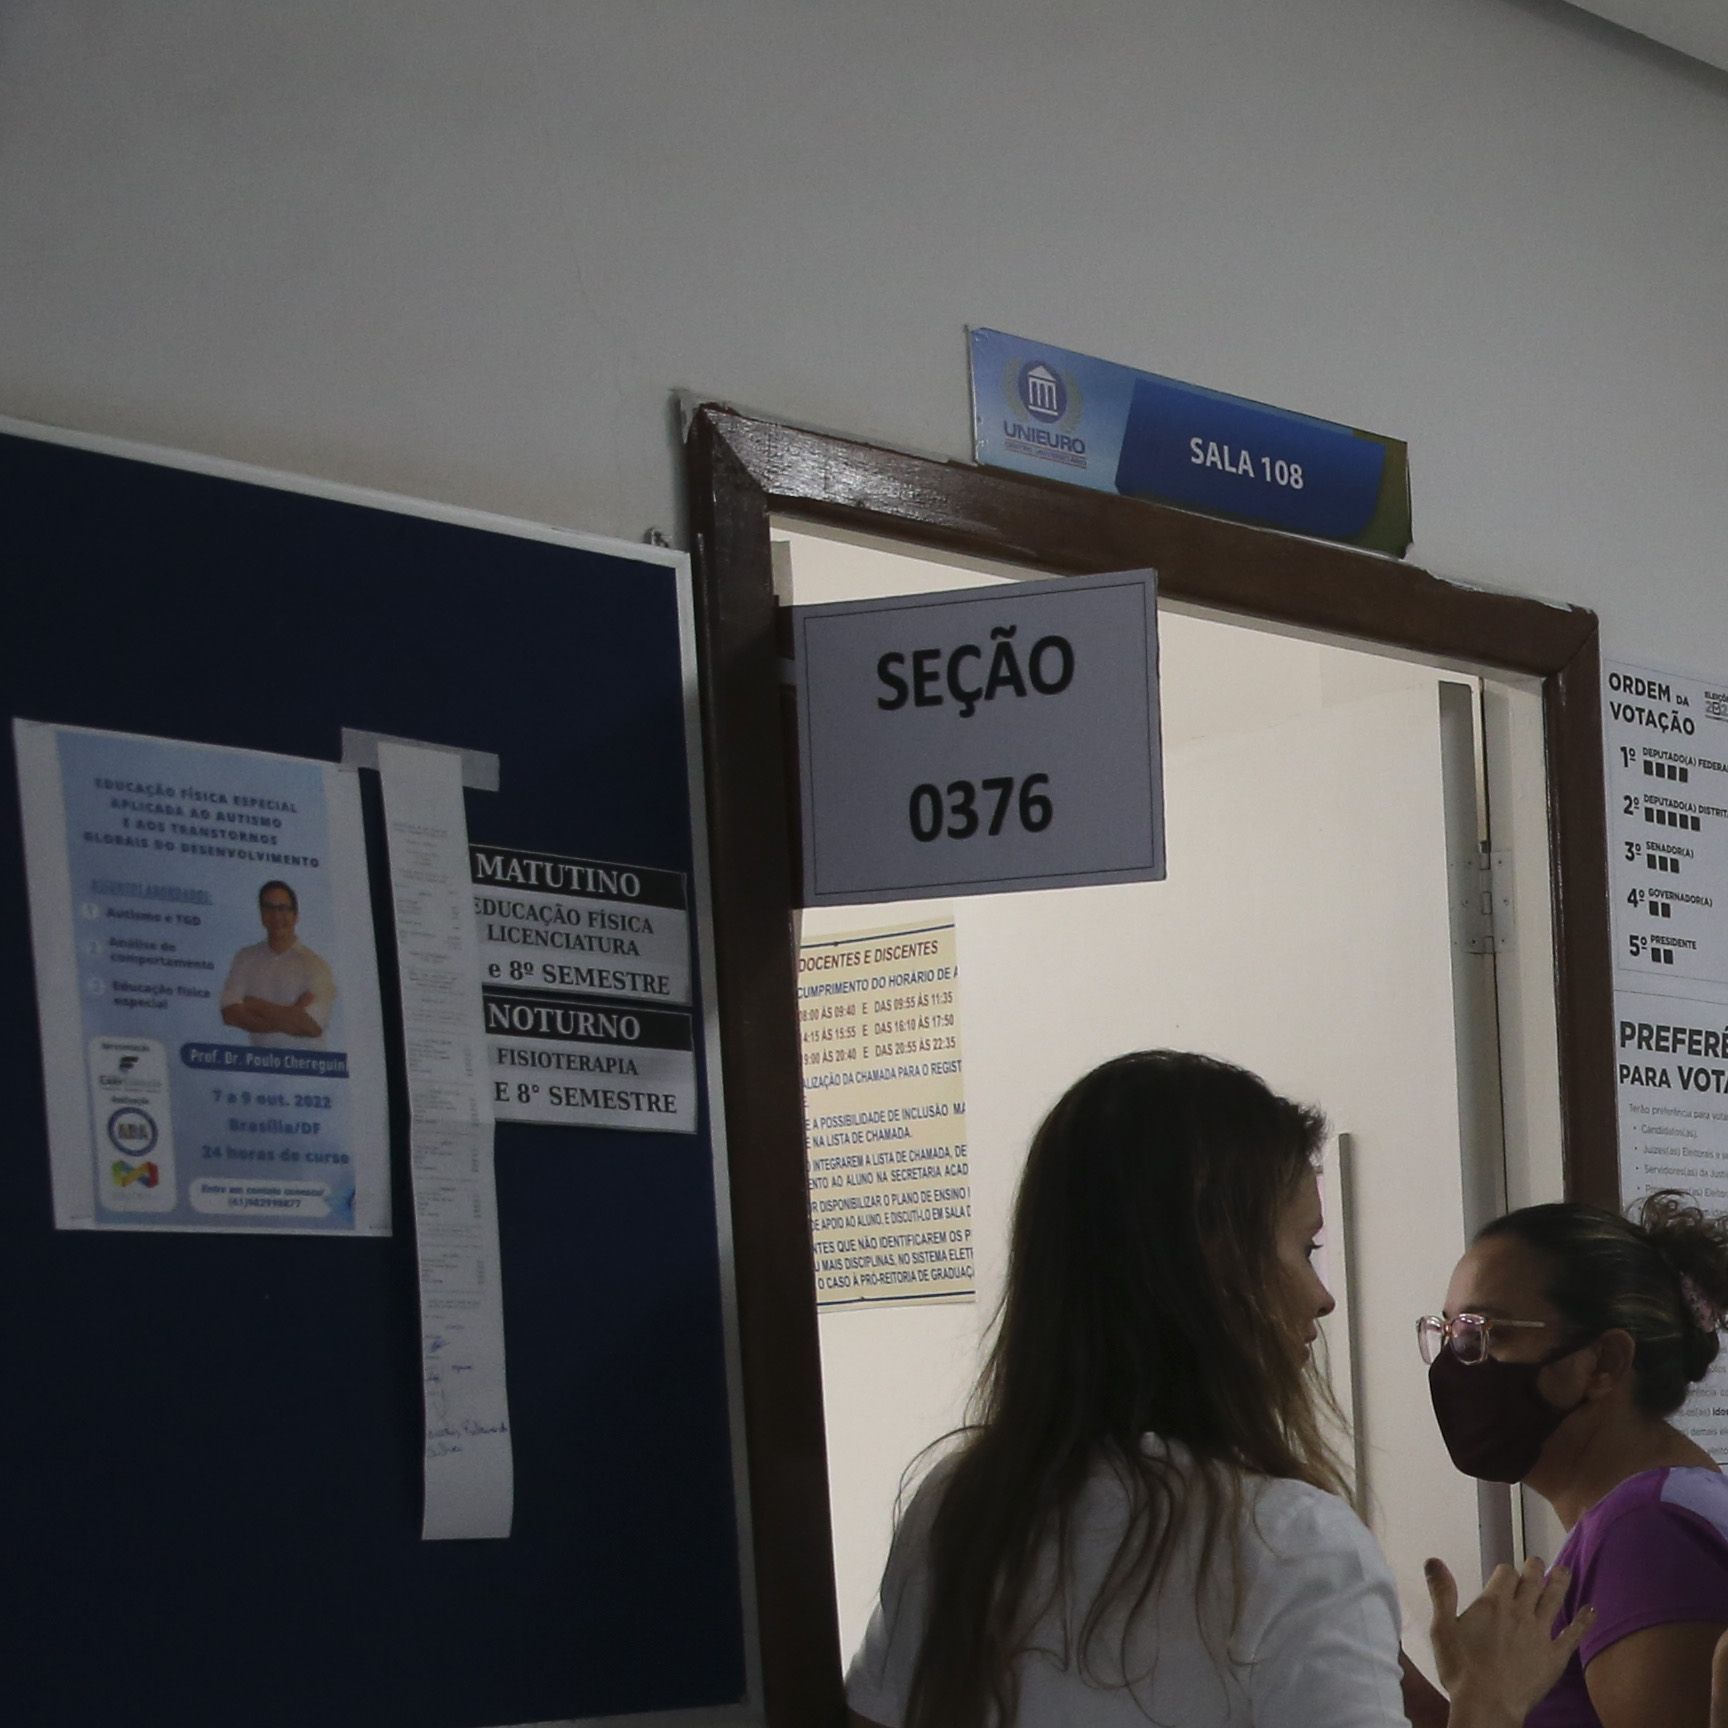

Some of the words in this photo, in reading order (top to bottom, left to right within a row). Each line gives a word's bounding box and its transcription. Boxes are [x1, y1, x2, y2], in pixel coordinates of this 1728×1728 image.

[1004, 420, 1086, 454] UNIEURO
[1190, 436, 1254, 479] SALA
[1261, 456, 1304, 490] 108
[877, 625, 1074, 719] SEÇÃO
[1609, 673, 1671, 702] ORDEM
[1676, 695, 1689, 706] DA
[1610, 701, 1695, 736] VOTAÇÃO
[1620, 746, 1636, 767] 1º
[1643, 747, 1696, 767] DEPUTADO(A)
[94, 778, 174, 798] EDUCAÇÃO
[181, 787, 227, 804] FÍSICA
[234, 795, 297, 813] ESPECIAL
[909, 773, 1052, 843] 0376
[1624, 795, 1639, 815] 2º
[1644, 794, 1696, 813] DEPUTADO(A)
[111, 798, 183, 815] APLICADA
[191, 808, 210, 820] AO
[216, 811, 282, 828] AUTISMO
[136, 820, 165, 832] AOS
[172, 823, 277, 845] TRANSTORNOS
[84, 831, 149, 848] GLOBAIS
[155, 840, 174, 851] DO
[181, 843, 319, 868] DESENVOLVIMENTO
[1625, 841, 1641, 861] 3º
[1646, 841, 1694, 858] SENADOR(A)
[476, 853, 640, 897] MATUTINO
[1627, 888, 1645, 908] 4º
[1648, 888, 1712, 907] GOVERNADOR(A)
[106, 908, 160, 922] Autismo
[474, 897, 580, 926] EDUCAÇÃO
[588, 909, 654, 934] FÍSICA
[488, 924, 640, 956] LICENCIATURA
[1629, 935, 1647, 956] 5º
[1651, 935, 1696, 949] PRESIDENTE
[111, 953, 214, 970] comportamento
[800, 952, 860, 972] DOCENTES
[864, 950, 870, 963] E
[875, 940, 938, 963] DISCENTES
[113, 981, 173, 996] Educação
[488, 963, 501, 978] e
[510, 961, 533, 980] 8º
[542, 964, 670, 995] SEMESTRE
[797, 979, 868, 999] CUMPRIMENTO
[872, 977, 885, 988] DO
[889, 969, 933, 987] HORÁRIO
[938, 967, 950, 979] DE
[863, 1003, 868, 1014] E
[875, 1000, 891, 1013] DAS
[932, 992, 952, 1005] 11:35
[488, 1003, 640, 1040] NOTURNO
[803, 1030, 819, 1042] 4:15
[863, 1025, 868, 1036] E
[875, 1022, 891, 1035] DAS
[932, 1014, 954, 1027] 17:50
[190, 1049, 220, 1064] Prof.
[224, 1052, 242, 1065] Dr.
[247, 1053, 280, 1068] Paulo
[498, 1048, 638, 1075] FISIOTERAPIA
[804, 1052, 819, 1065] 9:00
[864, 1047, 868, 1058] E
[875, 1044, 892, 1057] DAS
[933, 1036, 955, 1049] 22:35
[803, 1073, 840, 1089] ALIZAÇÃO
[842, 1072, 853, 1084] DA
[856, 1067, 895, 1083] CHAMADA
[899, 1065, 920, 1079] PARA
[922, 1064, 927, 1075] O
[932, 1060, 961, 1075] REGIST
[1620, 1064, 1671, 1088] PARA
[213, 1090, 222, 1102] 7
[257, 1092, 289, 1106] out.
[295, 1095, 331, 1108] 2022
[495, 1082, 509, 1102] E
[550, 1087, 677, 1113] SEMESTRE
[230, 1118, 320, 1135] Brasília/DF
[821, 1110, 885, 1129] POSSIBILIDADE
[888, 1109, 900, 1121] DE
[903, 1103, 948, 1119] INCLUSÃO
[814, 1136, 824, 1148] NA
[827, 1132, 850, 1146] LISTA
[852, 1132, 863, 1144] DE
[227, 1145, 274, 1161] horas
[306, 1153, 349, 1164] curso
[884, 1195, 889, 1206] O
[892, 1192, 918, 1205] PLANO
[921, 1190, 932, 1203] DE
[935, 1187, 966, 1201] ENSINO
[837, 1240, 855, 1252] QUE
[859, 1235, 877, 1249] NÃO
[880, 1231, 946, 1248] IDENTIFICAREM
[950, 1230, 962, 1242] OS
